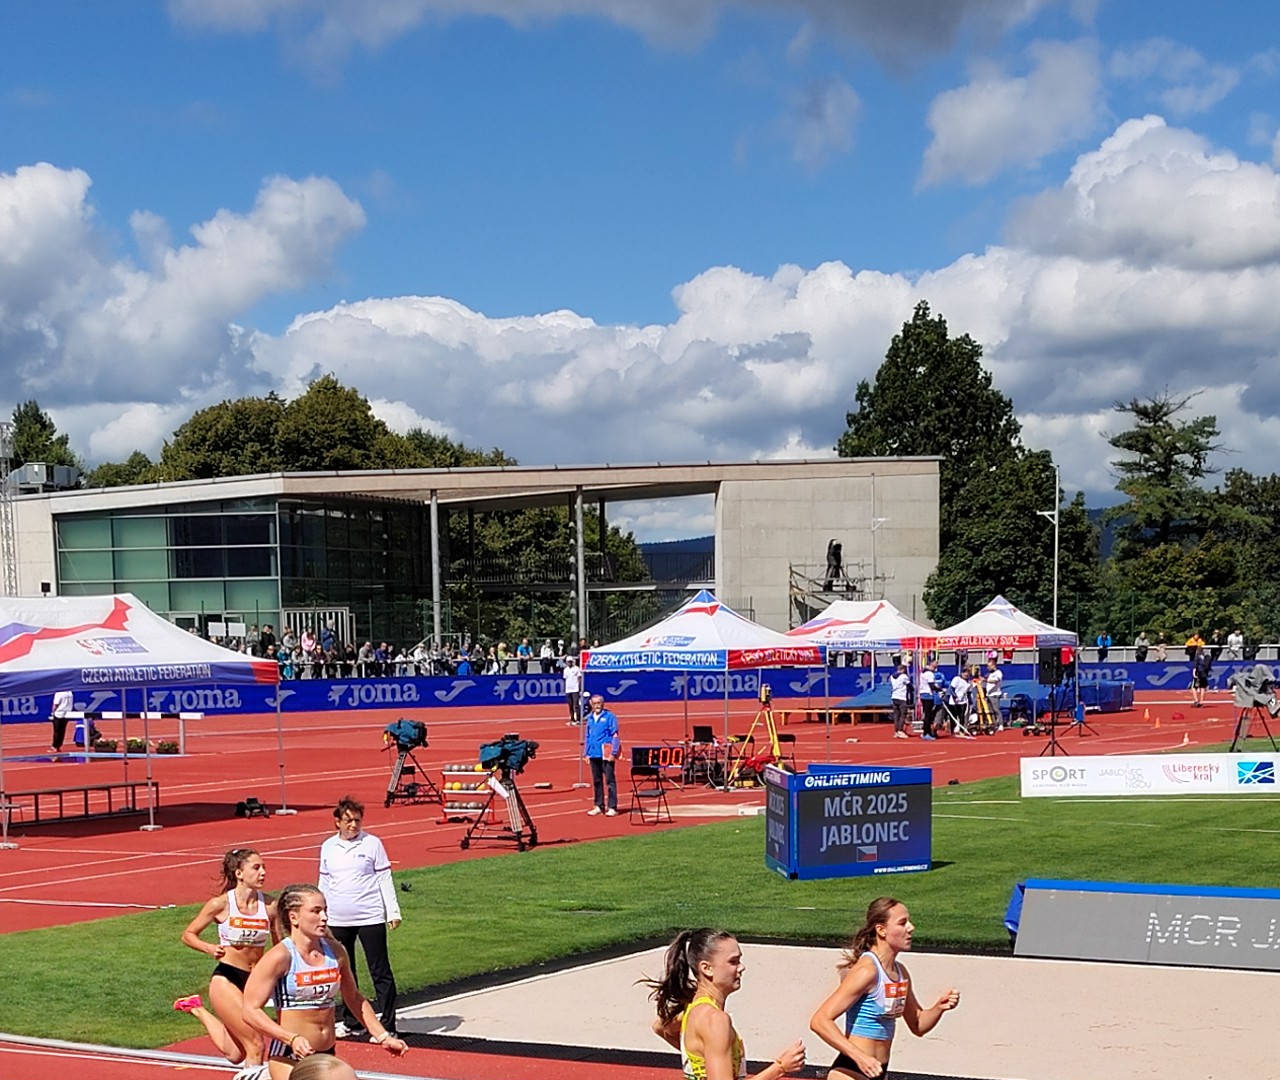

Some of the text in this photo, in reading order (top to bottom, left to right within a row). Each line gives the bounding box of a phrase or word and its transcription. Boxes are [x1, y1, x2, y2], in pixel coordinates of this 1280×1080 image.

[999, 635, 1020, 646] SVAZ
[589, 653, 618, 667] CZECH
[663, 653, 718, 666] FEDERATION
[81, 663, 211, 684] CZECH ATHLETIC FEDERATION
[347, 683, 420, 707] Joma
[511, 679, 566, 701] Jom
[690, 673, 759, 697] Joma
[168, 687, 242, 713] Joma
[648, 748, 683, 766] 1:00
[1032, 765, 1086, 782] SPORT
[1172, 763, 1220, 774] Liberecký
[804, 771, 891, 788] ONLINETIMING
[824, 791, 908, 817] MČR 2025
[820, 820, 910, 852] JABLONEC
